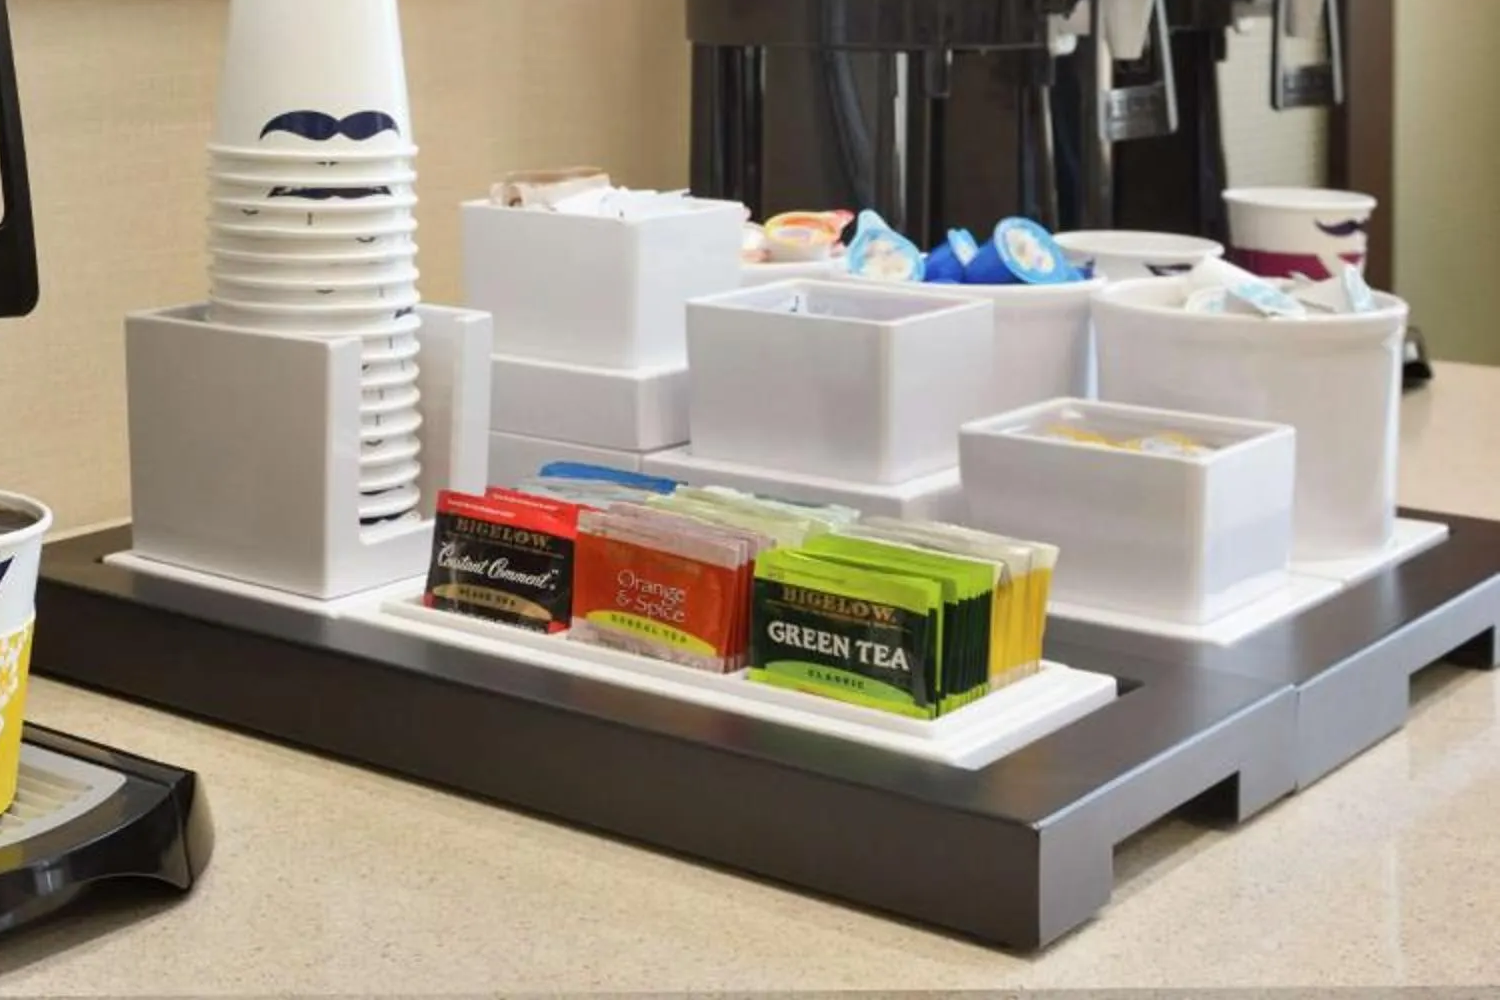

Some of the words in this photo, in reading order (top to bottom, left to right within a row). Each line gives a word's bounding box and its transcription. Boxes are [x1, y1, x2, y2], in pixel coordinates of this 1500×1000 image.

[617, 568, 686, 607] Orange
[634, 594, 686, 623] Spice
[767, 620, 850, 660] GREEN
[855, 640, 910, 671] TEA
